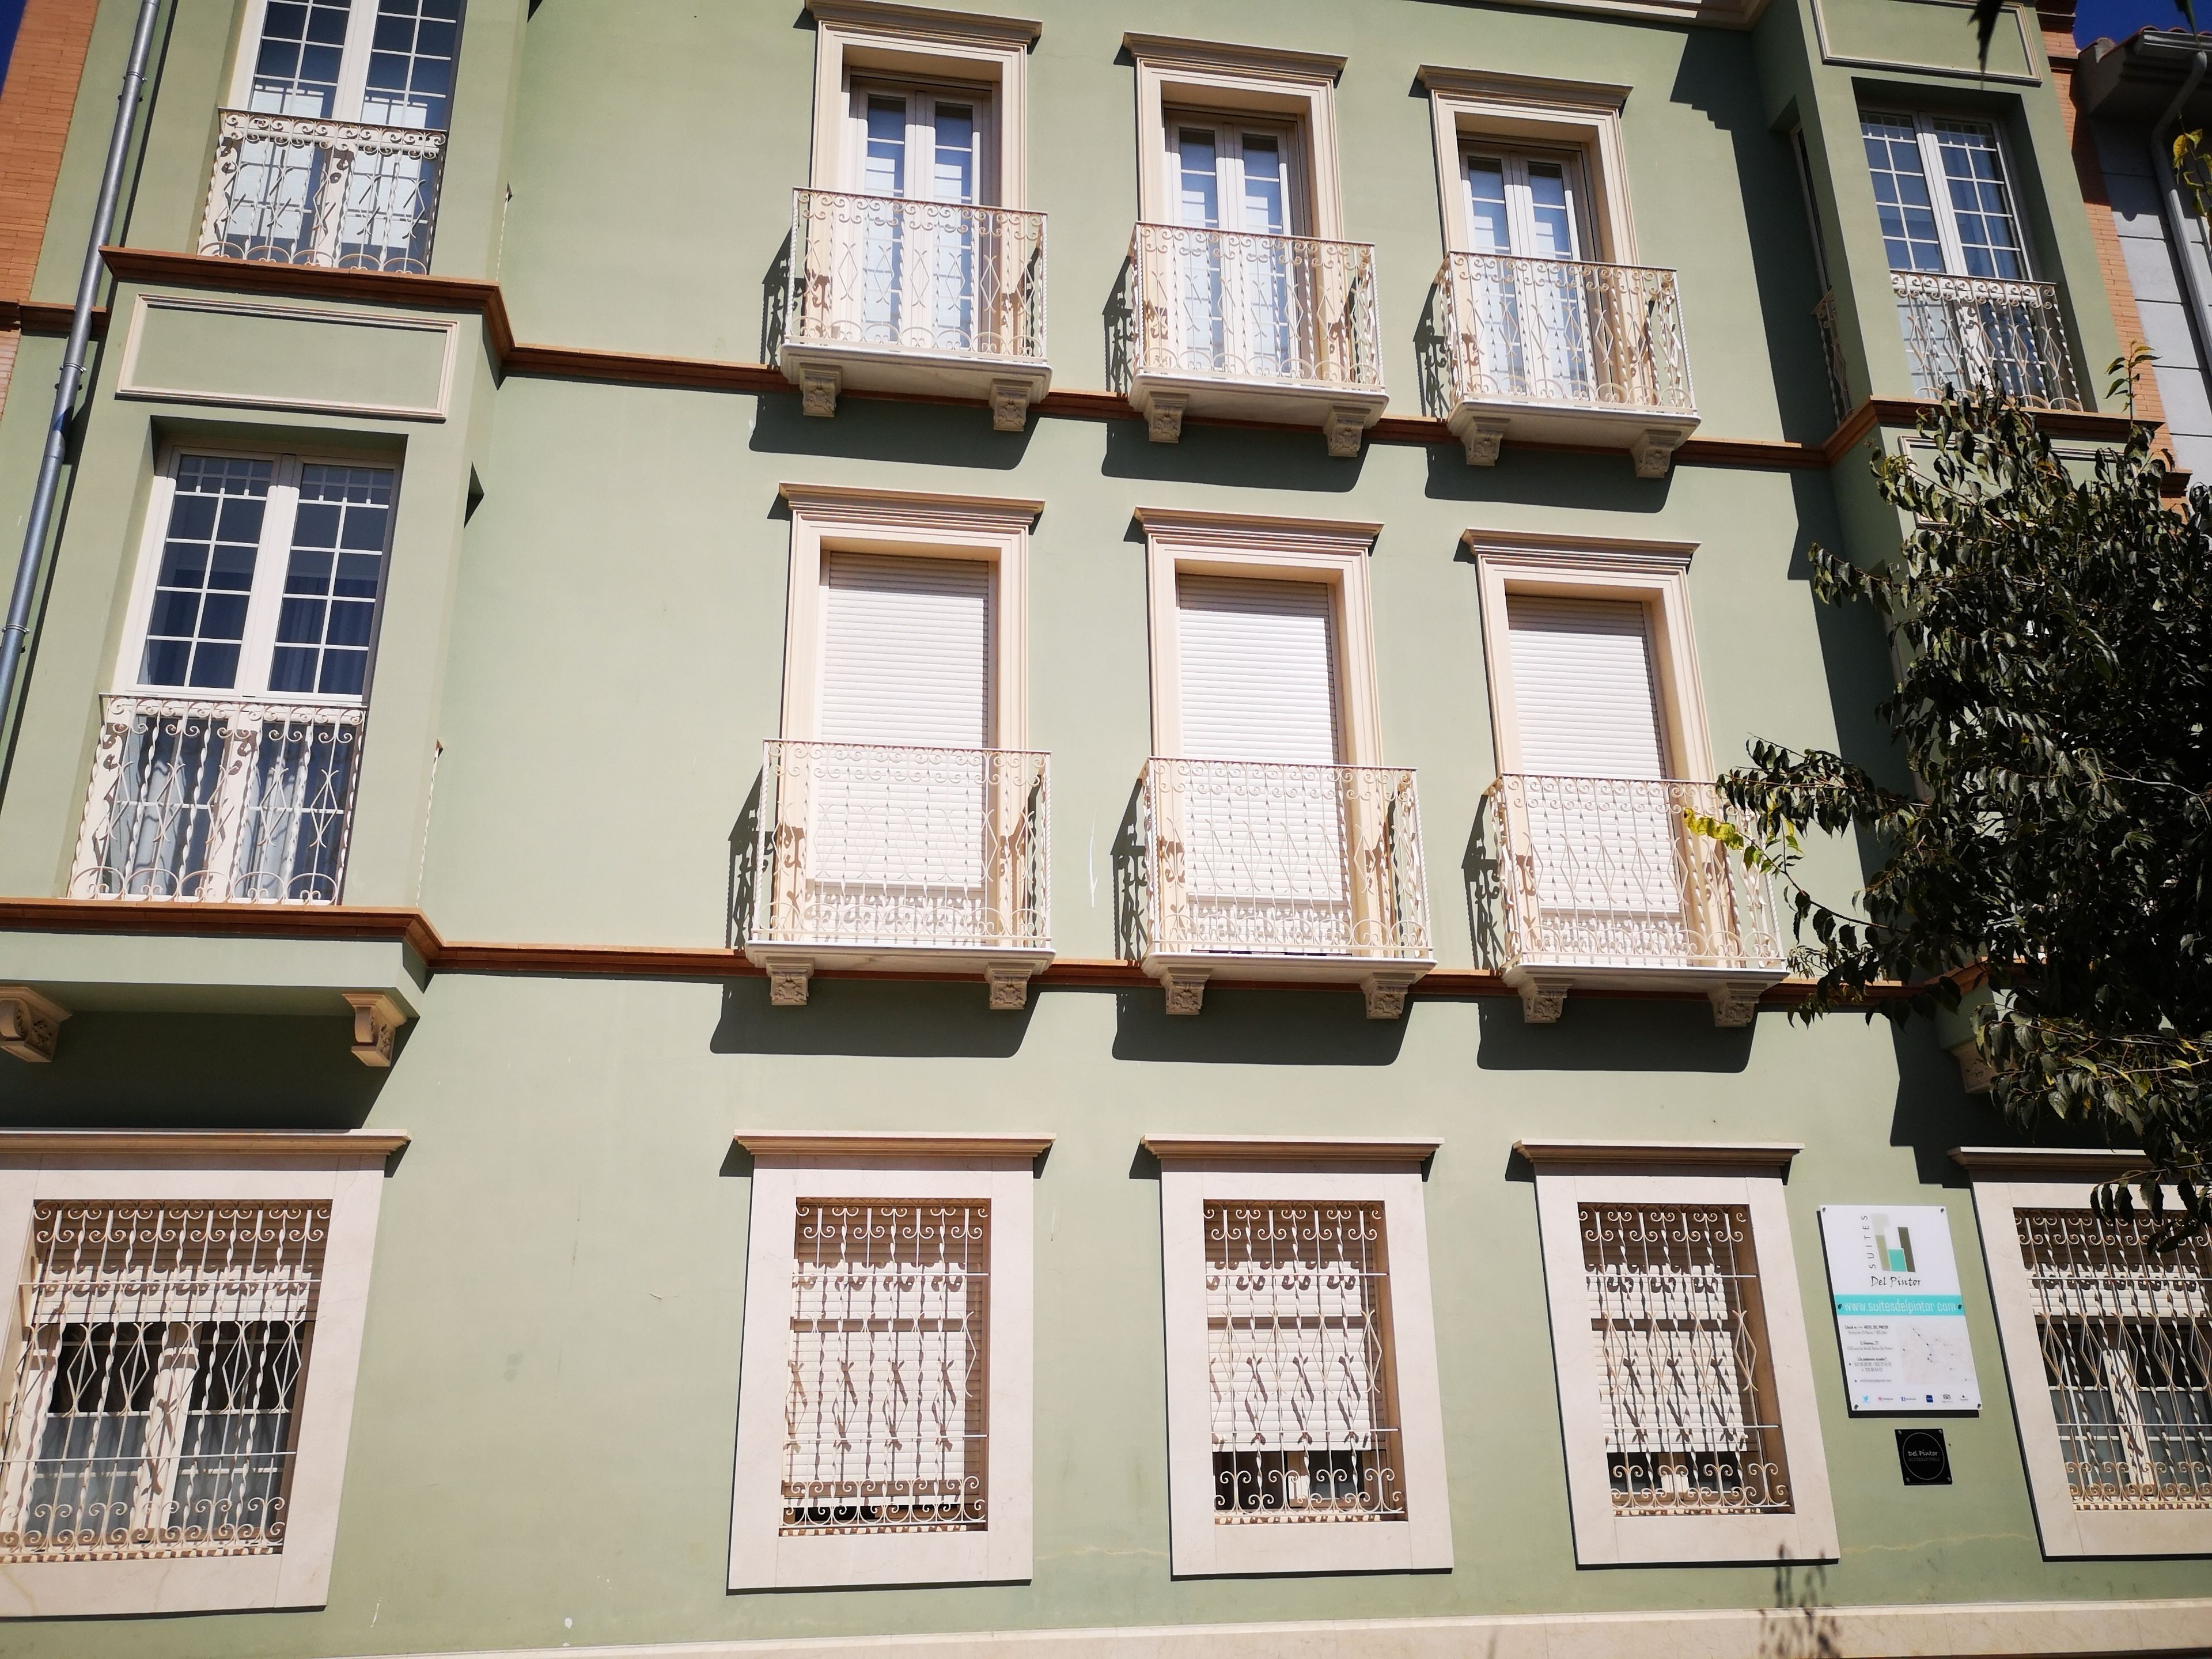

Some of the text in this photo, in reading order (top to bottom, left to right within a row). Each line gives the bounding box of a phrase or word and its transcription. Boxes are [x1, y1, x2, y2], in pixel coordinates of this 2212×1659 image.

[1861, 1215, 1876, 1269] SUITES
[1871, 1275, 1922, 1287] Del Pintor
